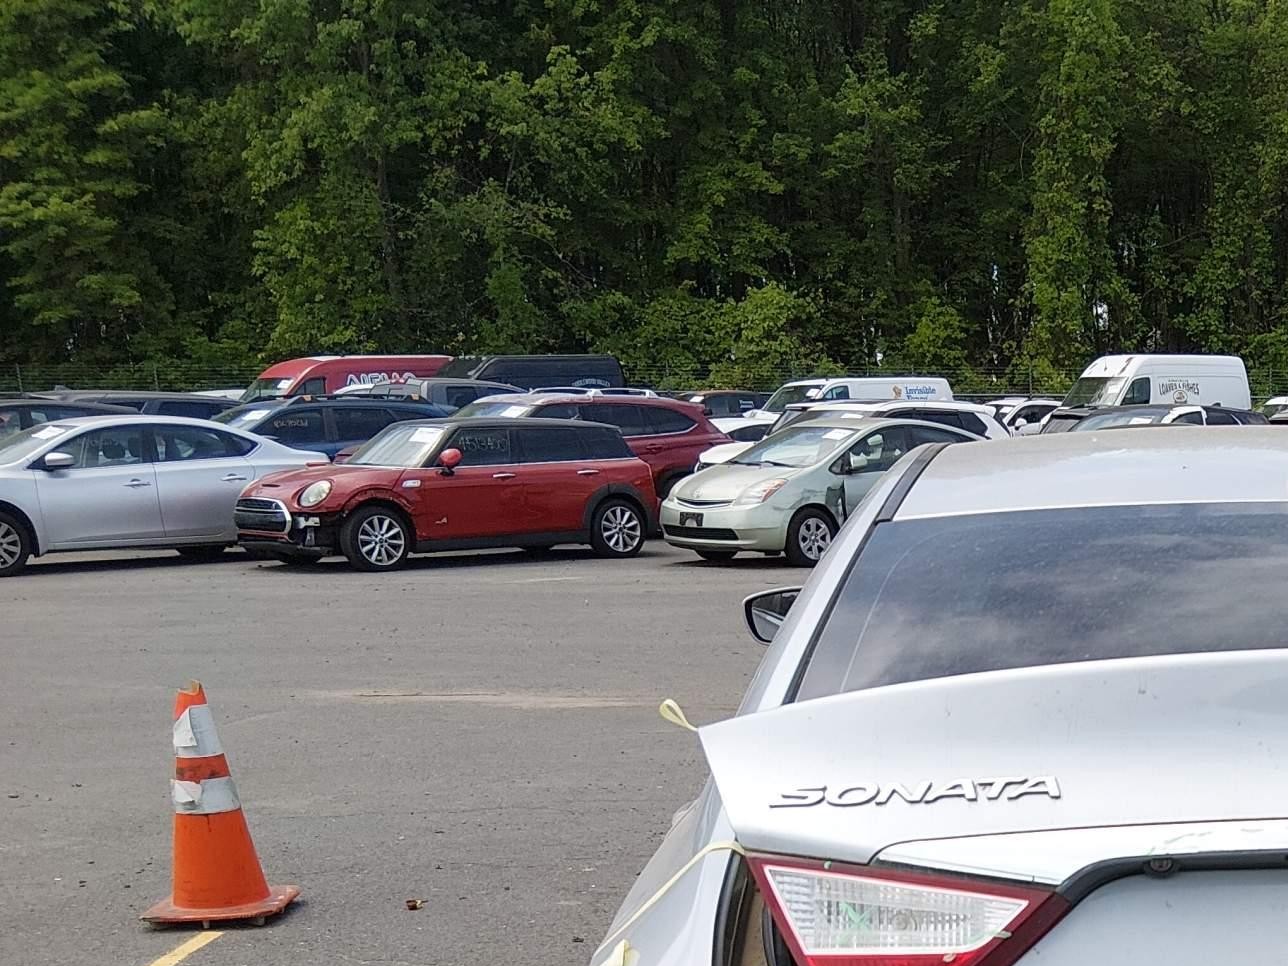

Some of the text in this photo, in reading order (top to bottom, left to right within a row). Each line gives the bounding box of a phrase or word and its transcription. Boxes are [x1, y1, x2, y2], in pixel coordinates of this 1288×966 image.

[904, 385, 937, 395] Invisible
[1159, 382, 1177, 396] LOAVES
[1182, 382, 1200, 396] FISHES
[768, 775, 1062, 809] SONATA
